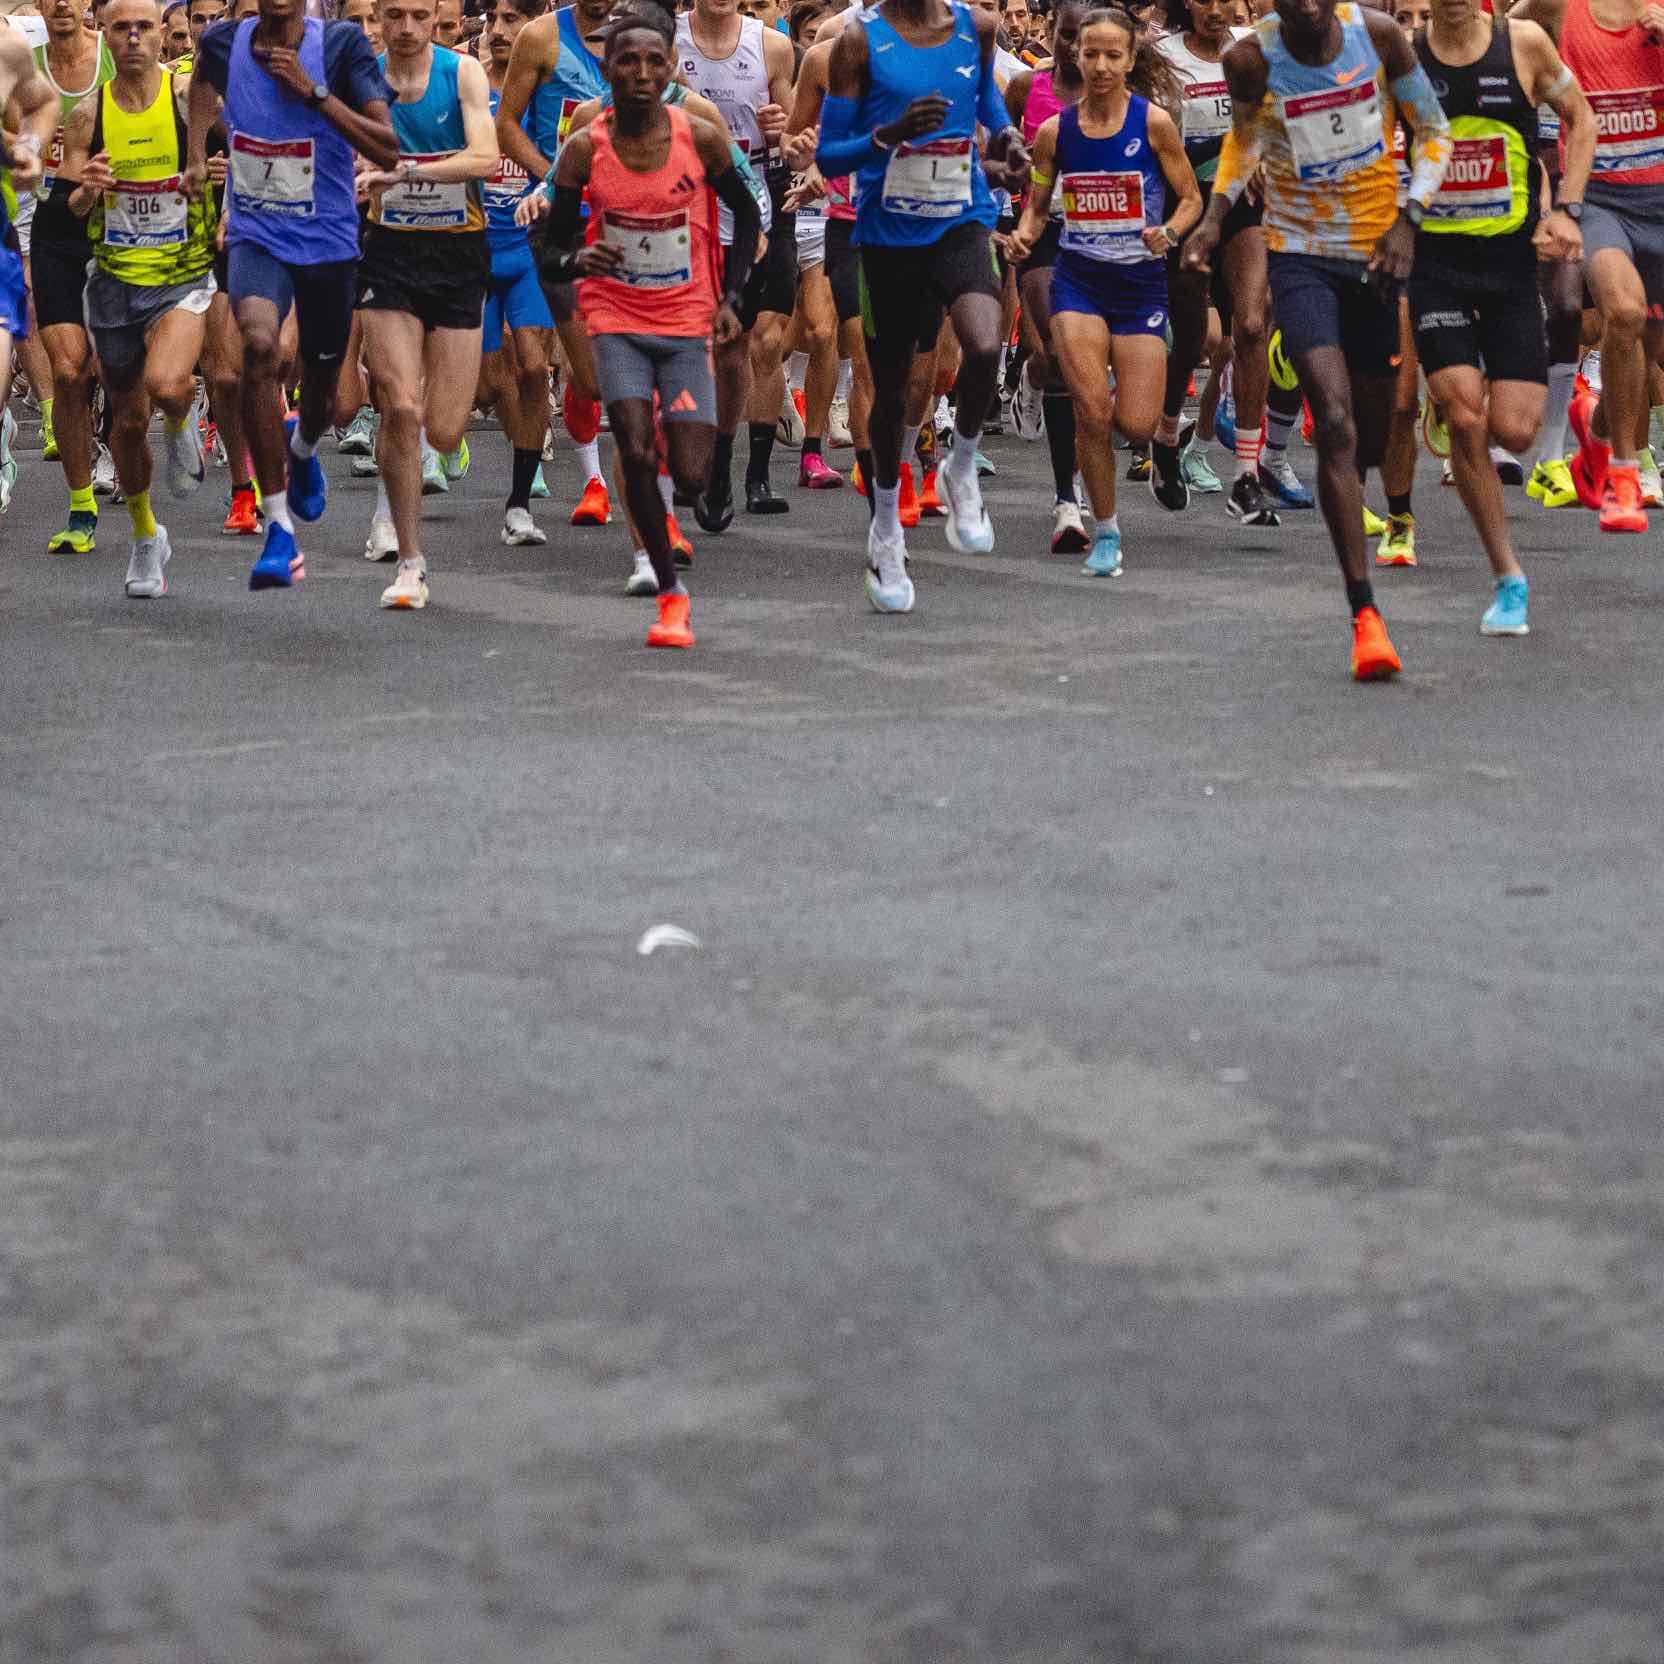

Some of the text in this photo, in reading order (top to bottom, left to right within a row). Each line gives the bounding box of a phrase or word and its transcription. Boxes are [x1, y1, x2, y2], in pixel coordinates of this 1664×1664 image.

[1330, 113, 1343, 135] 2
[1598, 109, 1657, 136] 20003
[264, 161, 273, 179] 7
[932, 160, 938, 181] 1
[128, 197, 160, 215] 306
[1077, 191, 1128, 213] 20012
